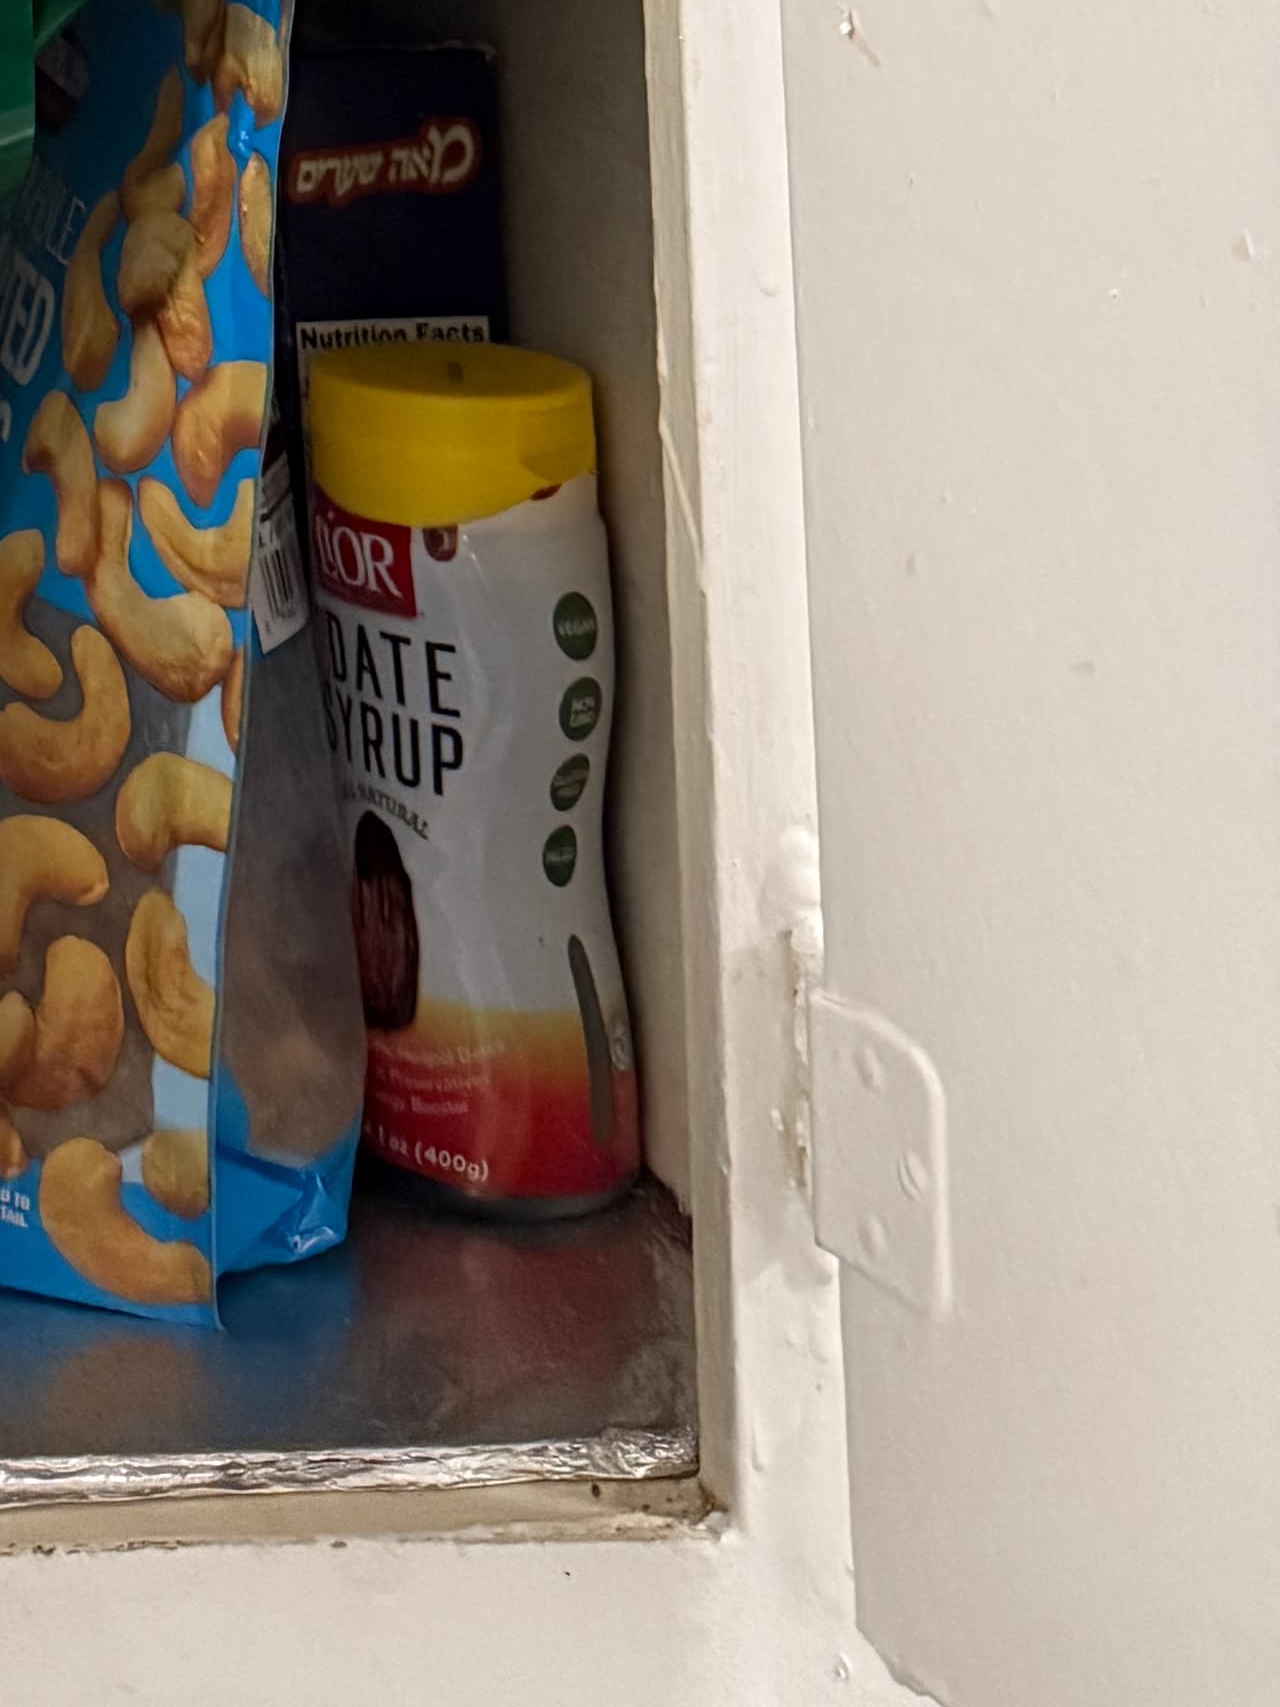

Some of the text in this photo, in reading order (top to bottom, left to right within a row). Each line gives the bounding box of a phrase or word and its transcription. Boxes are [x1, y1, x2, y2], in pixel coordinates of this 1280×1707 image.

[324, 608, 461, 719] DATE
[320, 681, 464, 796] SYRUP
[414, 1140, 489, 1182] (400g)
